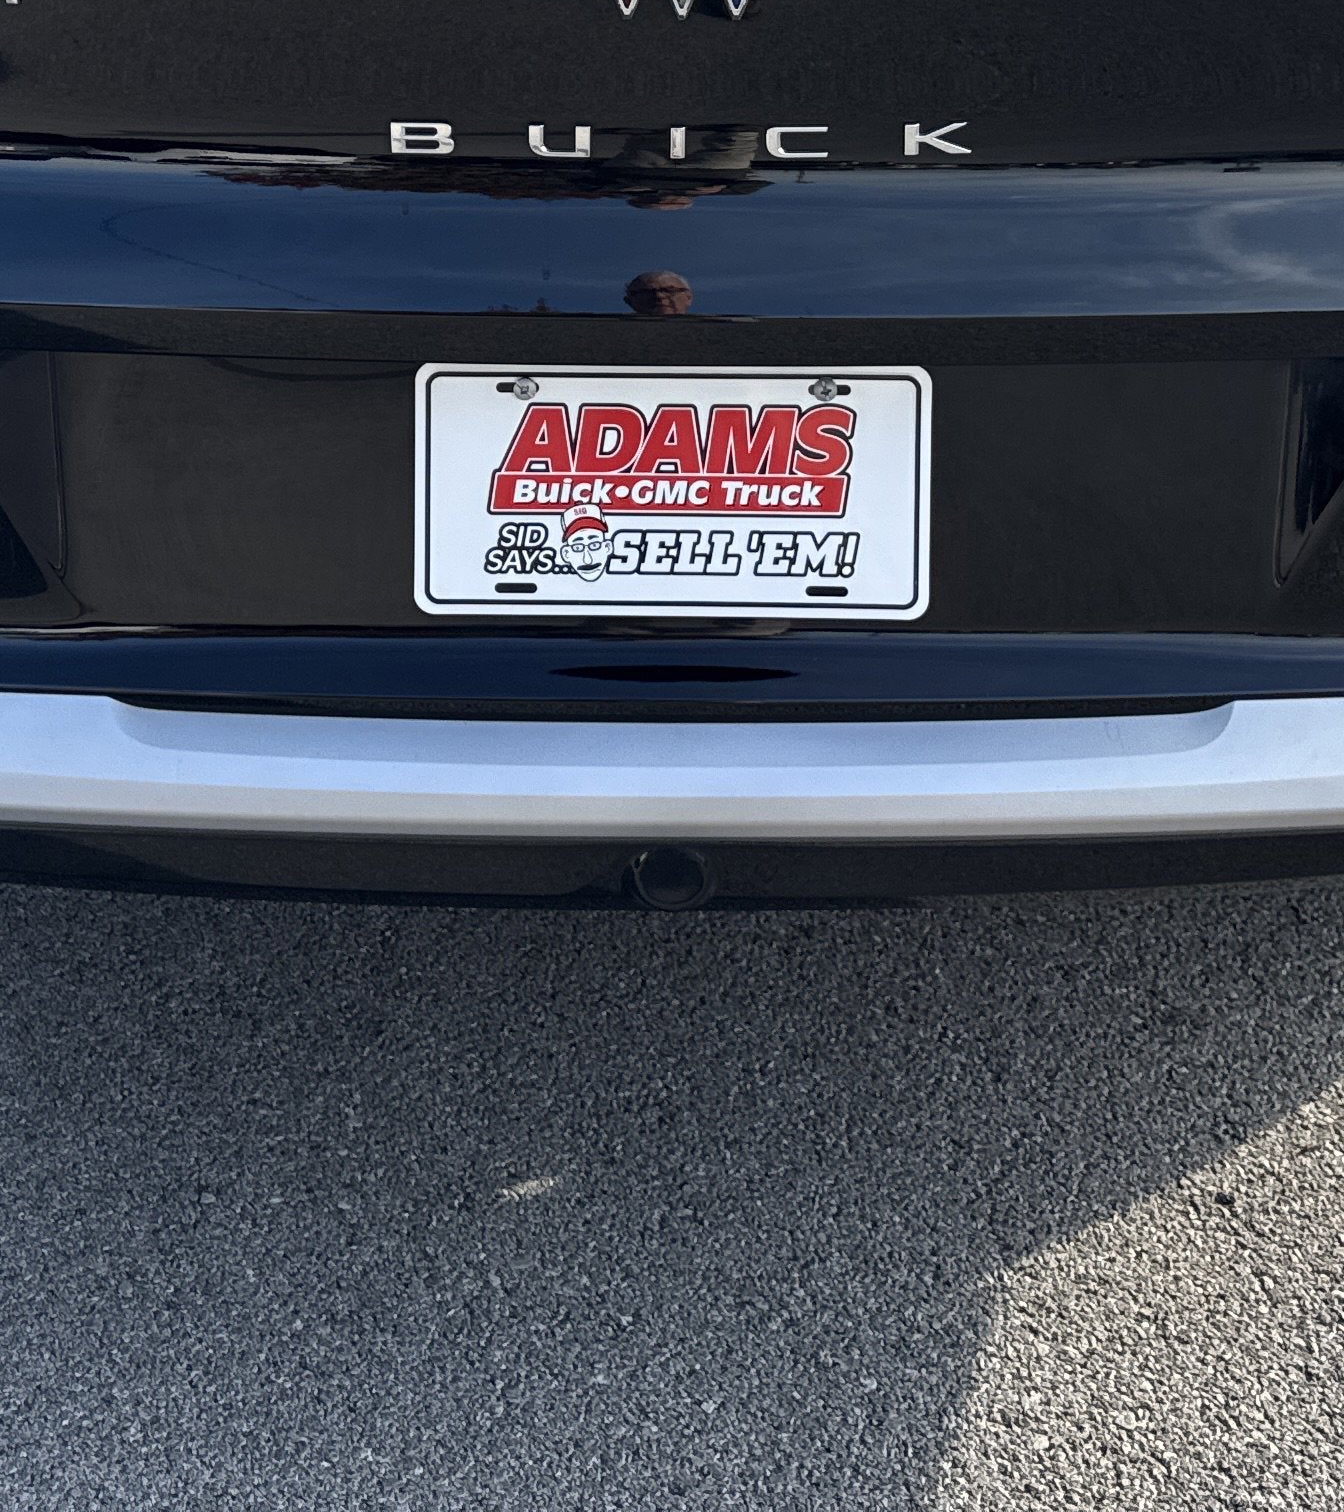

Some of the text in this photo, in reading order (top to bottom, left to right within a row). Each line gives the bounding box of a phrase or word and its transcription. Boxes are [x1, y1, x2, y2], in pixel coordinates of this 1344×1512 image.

[390, 121, 973, 159] BUICK
[500, 403, 857, 477] ADAMS
[719, 480, 824, 508] Truck
[499, 522, 548, 550] SID
[606, 530, 742, 577] SELL
